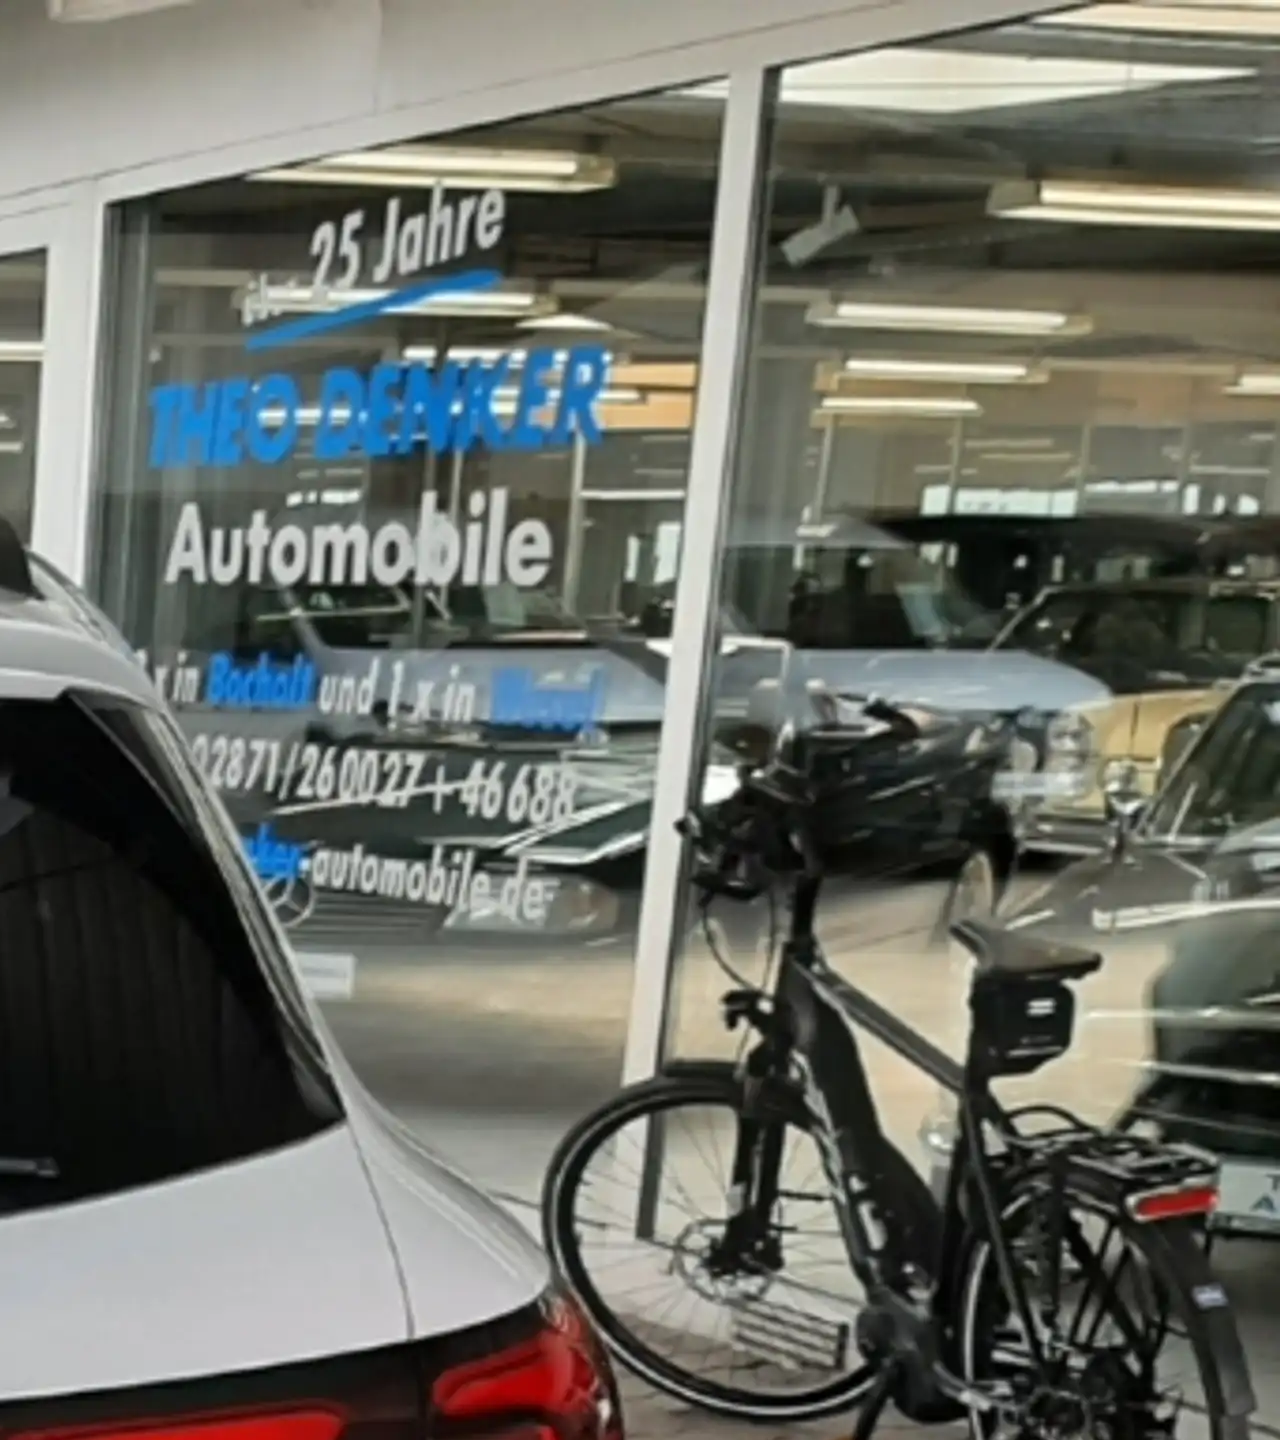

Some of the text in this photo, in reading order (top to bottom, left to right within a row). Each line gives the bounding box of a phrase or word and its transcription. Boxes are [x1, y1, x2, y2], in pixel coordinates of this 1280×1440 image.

[309, 208, 365, 302] 25
[372, 178, 505, 283] Jahre
[148, 345, 611, 468] THEO DENKER
[164, 486, 553, 587] Automobile
[174, 650, 199, 703] in
[319, 656, 380, 717] und
[443, 663, 476, 725] in
